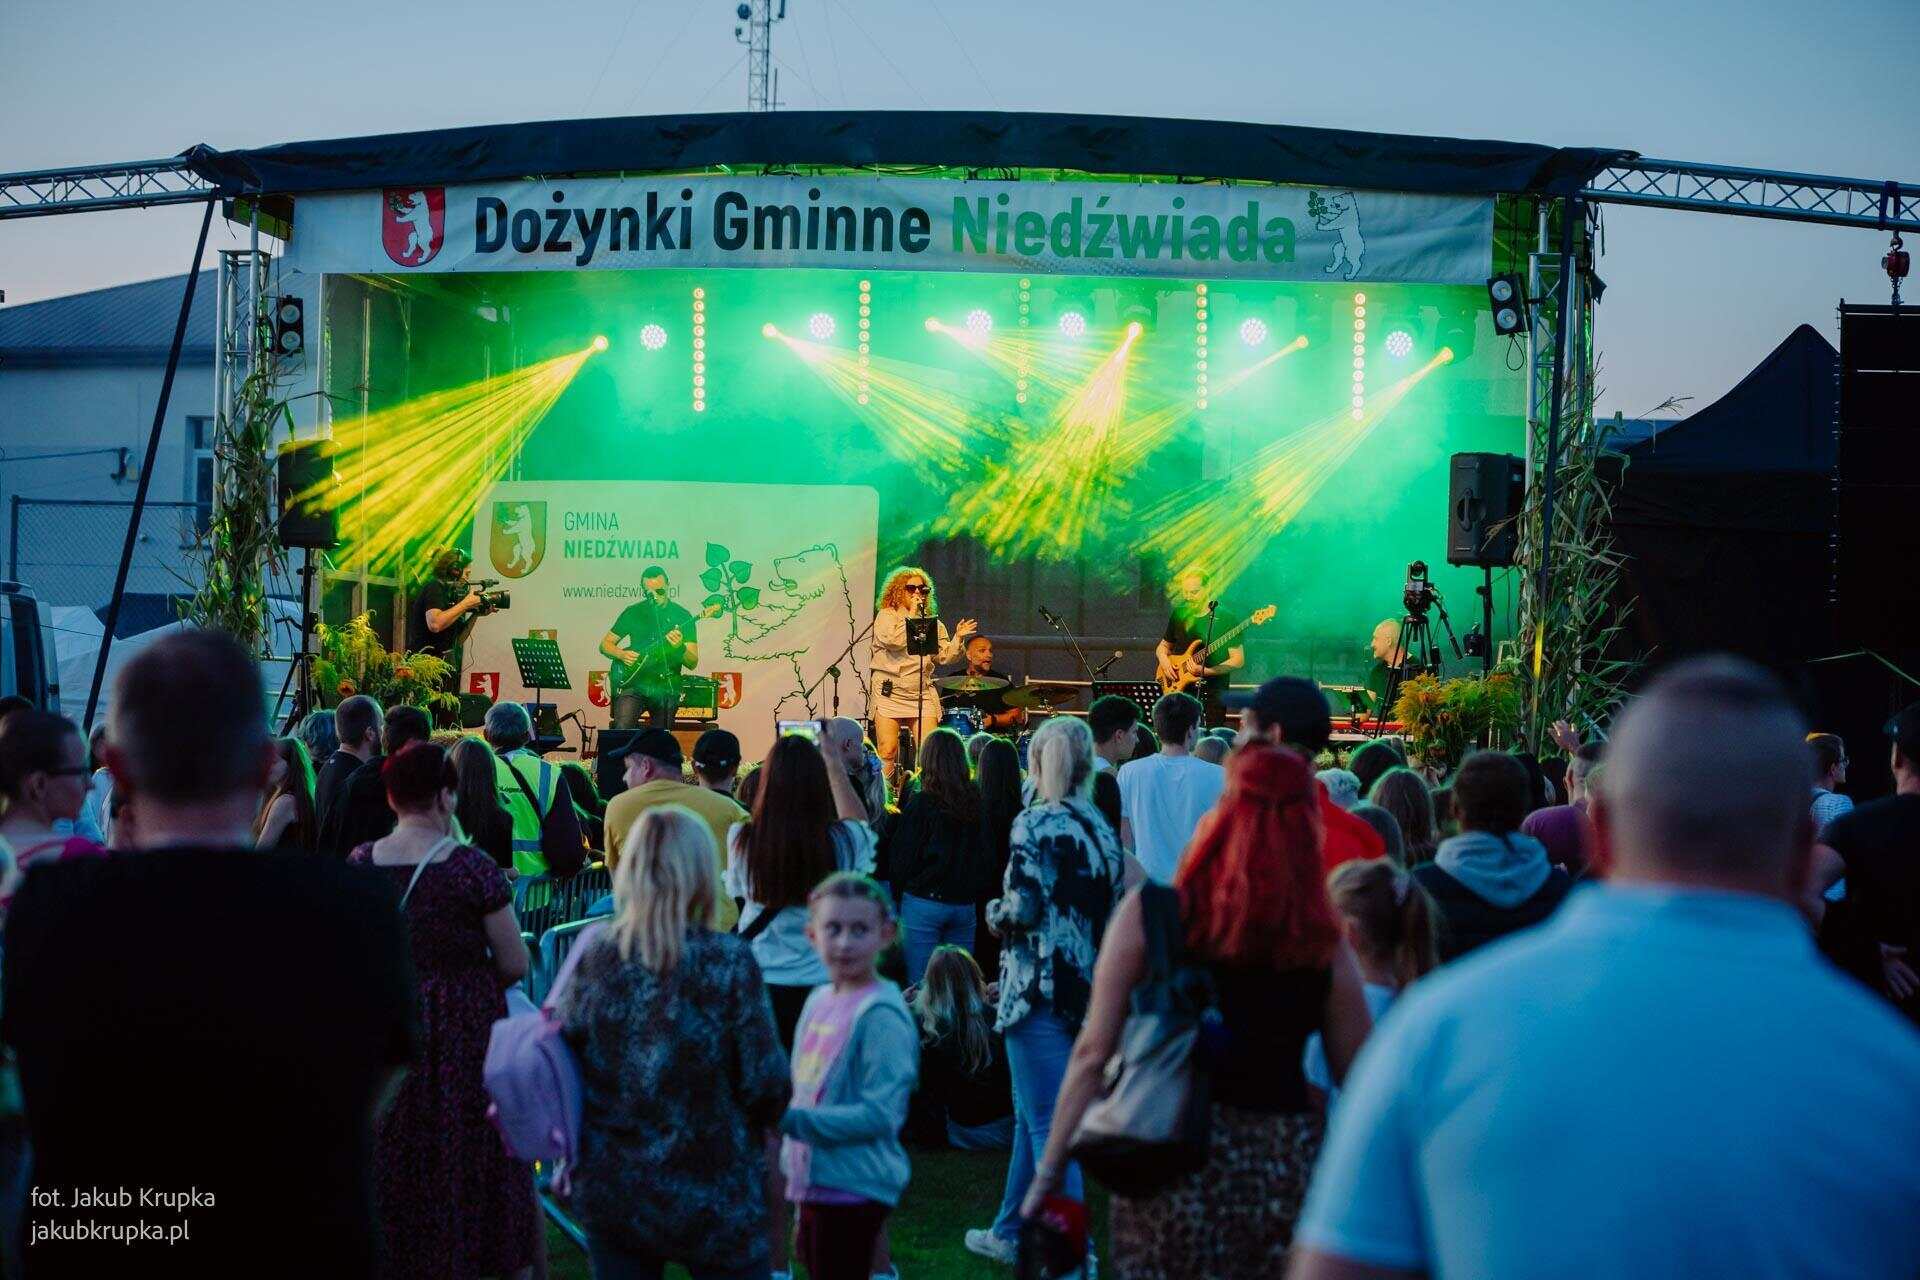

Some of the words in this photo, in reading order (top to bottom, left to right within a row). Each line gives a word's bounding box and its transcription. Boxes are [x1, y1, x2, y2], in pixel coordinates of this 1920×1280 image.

[475, 188, 693, 267] Dożynki
[713, 187, 931, 253] Gminne
[952, 192, 1297, 263] Niedźwiada
[564, 511, 619, 531] GMINA
[564, 534, 679, 559] NIEDŹWIADA
